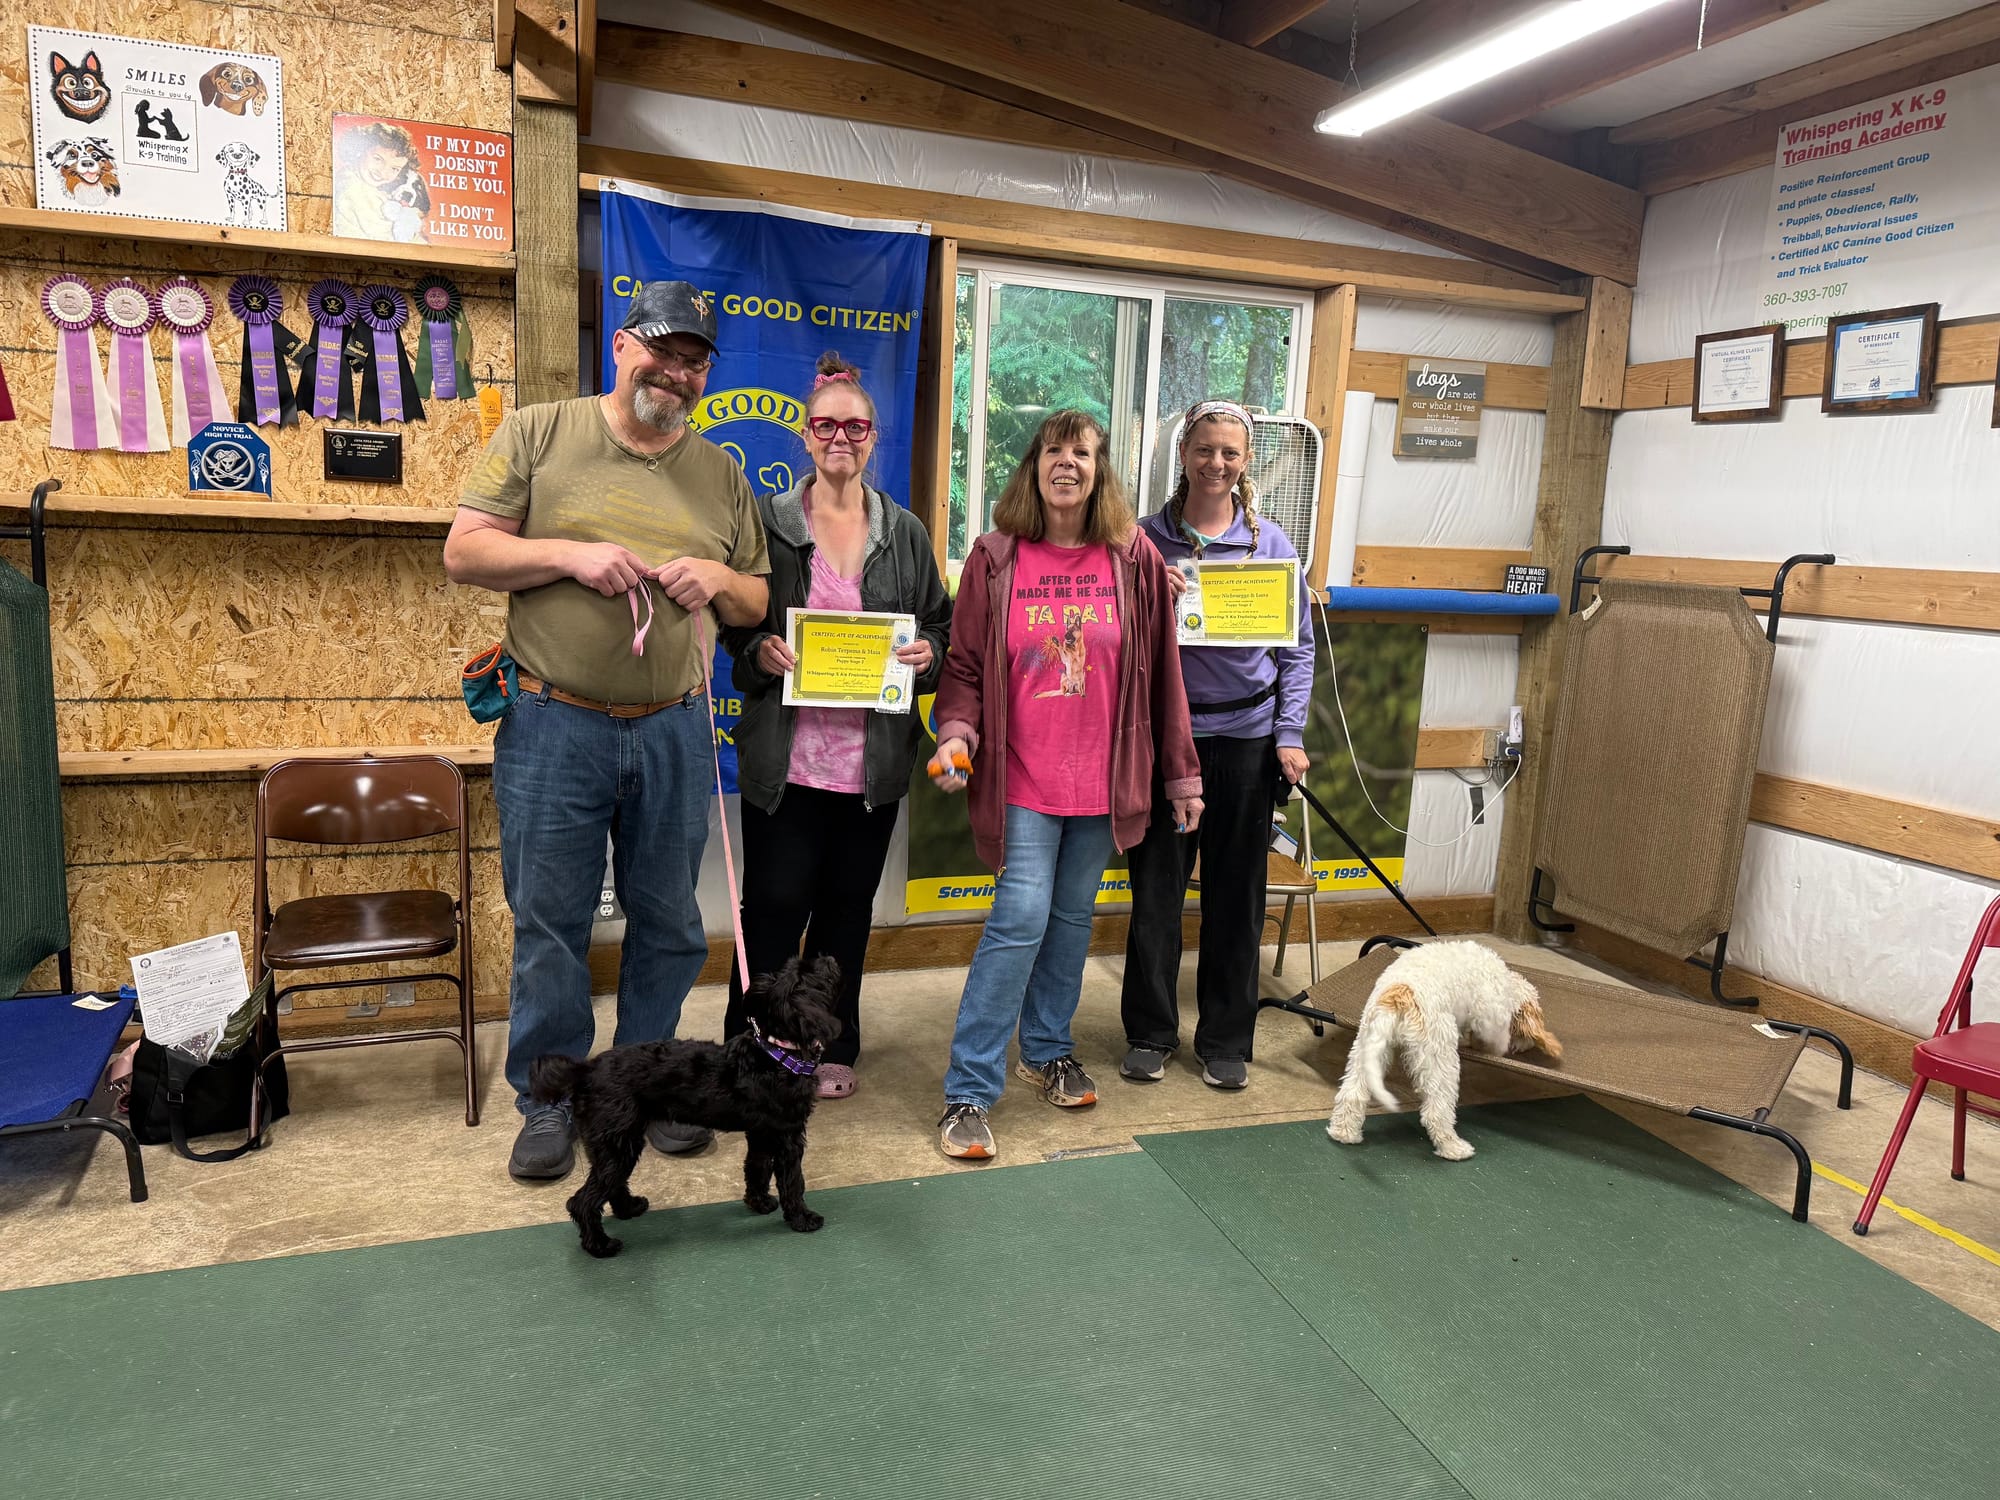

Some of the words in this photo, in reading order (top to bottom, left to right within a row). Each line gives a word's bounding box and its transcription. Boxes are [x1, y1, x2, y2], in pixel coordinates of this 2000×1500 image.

[125, 68, 186, 86] SMILES
[184, 92, 192, 100] by
[1786, 109, 1884, 146] Whispering
[1889, 100, 1904, 118] X
[1909, 88, 1947, 113] K-9
[138, 140, 181, 154] Whispering
[426, 135, 443, 151] IF
[446, 137, 471, 154] MY
[474, 140, 506, 158] DOG
[1783, 138, 1852, 166] Training
[1857, 112, 1947, 148] Academy
[138, 150, 154, 159] K-9
[156, 152, 187, 165] Training
[434, 154, 498, 175] DOESN'T
[1779, 177, 1814, 194] Positive
[1816, 160, 1894, 184] Reinforcement
[1896, 152, 1930, 167] Group
[428, 173, 468, 191] LIKE
[472, 177, 506, 197] YOU,
[1777, 200, 1796, 212] and
[1798, 193, 1827, 209] private
[1830, 183, 1876, 199] classes!
[439, 202, 446, 217] I
[450, 204, 495, 222] DON'T
[1786, 212, 1823, 228] Puppies,
[1825, 200, 1886, 217] Obedience,
[1888, 194, 1919, 206] Rally,
[429, 220, 469, 238] LIKE
[472, 224, 507, 241] YOU.
[1781, 229, 1824, 246] Treibball,
[1825, 218, 1881, 237] Behavioral
[1884, 212, 1919, 227] Issues
[1778, 245, 1820, 261] Certified
[1821, 241, 1840, 254] AKC
[1842, 234, 1882, 248] Canine
[1885, 228, 1913, 242] Good
[1915, 221, 1955, 237] Citizen
[1777, 268, 1796, 279] and
[1799, 264, 1821, 276] Trick
[1823, 254, 1869, 270] Evaluator
[1763, 282, 1849, 307] 360-393-7097
[722, 294, 803, 322] GOOD
[1858, 332, 1900, 342] CERTIFICATE
[1416, 363, 1462, 400] dogs
[1447, 391, 1461, 399] are
[1463, 392, 1477, 400] not
[706, 393, 800, 424] GOOD
[1429, 401, 1452, 411] whole
[1454, 402, 1476, 412] lives
[1426, 412, 1440, 421] but
[1442, 413, 1460, 424] they
[212, 425, 245, 433] NOVICE
[1423, 424, 1442, 433] make
[1415, 436, 1438, 446] lives
[1440, 438, 1463, 447] whole
[1038, 575, 1072, 586] AFTER
[1075, 574, 1098, 585] GOD
[1509, 566, 1514, 574] A
[1514, 566, 1528, 575] DOG
[1528, 568, 1546, 576] WAGS
[1016, 587, 1050, 599] MADE
[1054, 587, 1072, 598] ME
[1077, 586, 1091, 598] HE
[1506, 580, 1544, 595] HEART
[1024, 604, 1056, 625] TA
[1062, 603, 1099, 625] DA
[1104, 603, 1113, 624] !
[1334, 867, 1369, 879] 1995
